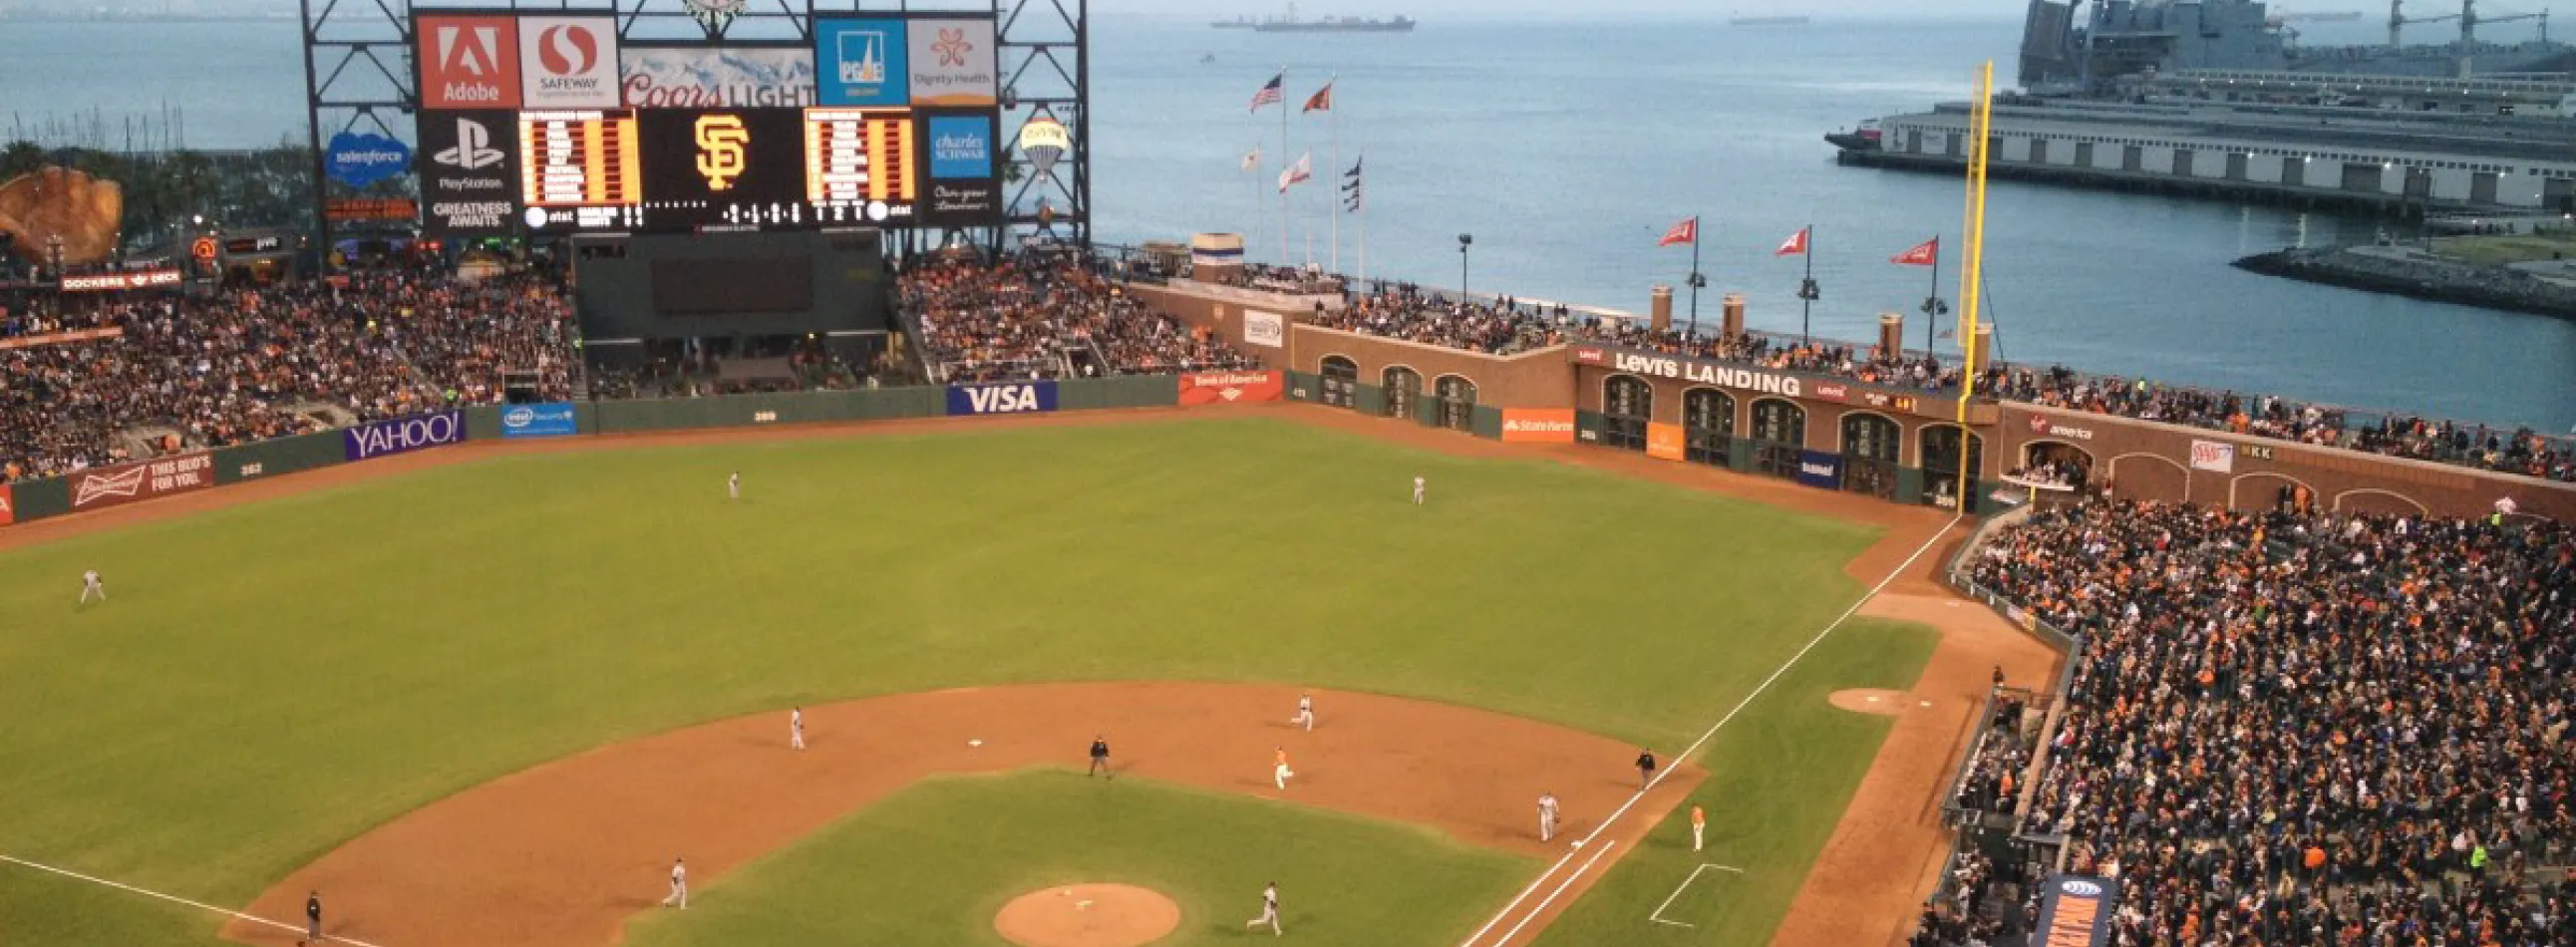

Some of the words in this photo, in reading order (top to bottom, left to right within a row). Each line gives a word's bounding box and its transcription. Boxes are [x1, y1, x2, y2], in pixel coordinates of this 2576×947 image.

[539, 77, 599, 90] SAFEWAY
[913, 74, 953, 86] Dignity
[954, 74, 990, 84] Health
[444, 82, 499, 102] Adobe
[617, 74, 723, 107] Coors
[729, 84, 817, 107] LIGHT
[935, 133, 984, 149] charles
[336, 150, 403, 167] salesforce
[439, 177, 503, 192] PlayStation
[433, 201, 513, 215] GREATNESS
[63, 276, 126, 289] DOCKERS
[151, 270, 180, 283] DECK
[1194, 374, 1219, 387] Bank
[1218, 375, 1229, 385] of
[1230, 373, 1268, 385] America
[1685, 362, 1800, 397] LANDING
[964, 384, 1038, 412] VISA
[1517, 419, 1547, 432] State
[1546, 421, 1575, 432] Farm
[2049, 426, 2093, 441] america
[351, 410, 460, 459] YAHOO!
[151, 462, 176, 476] THIS
[177, 456, 211, 473] BUD'S
[152, 477, 174, 491] FOR
[175, 473, 200, 487] YOU.
